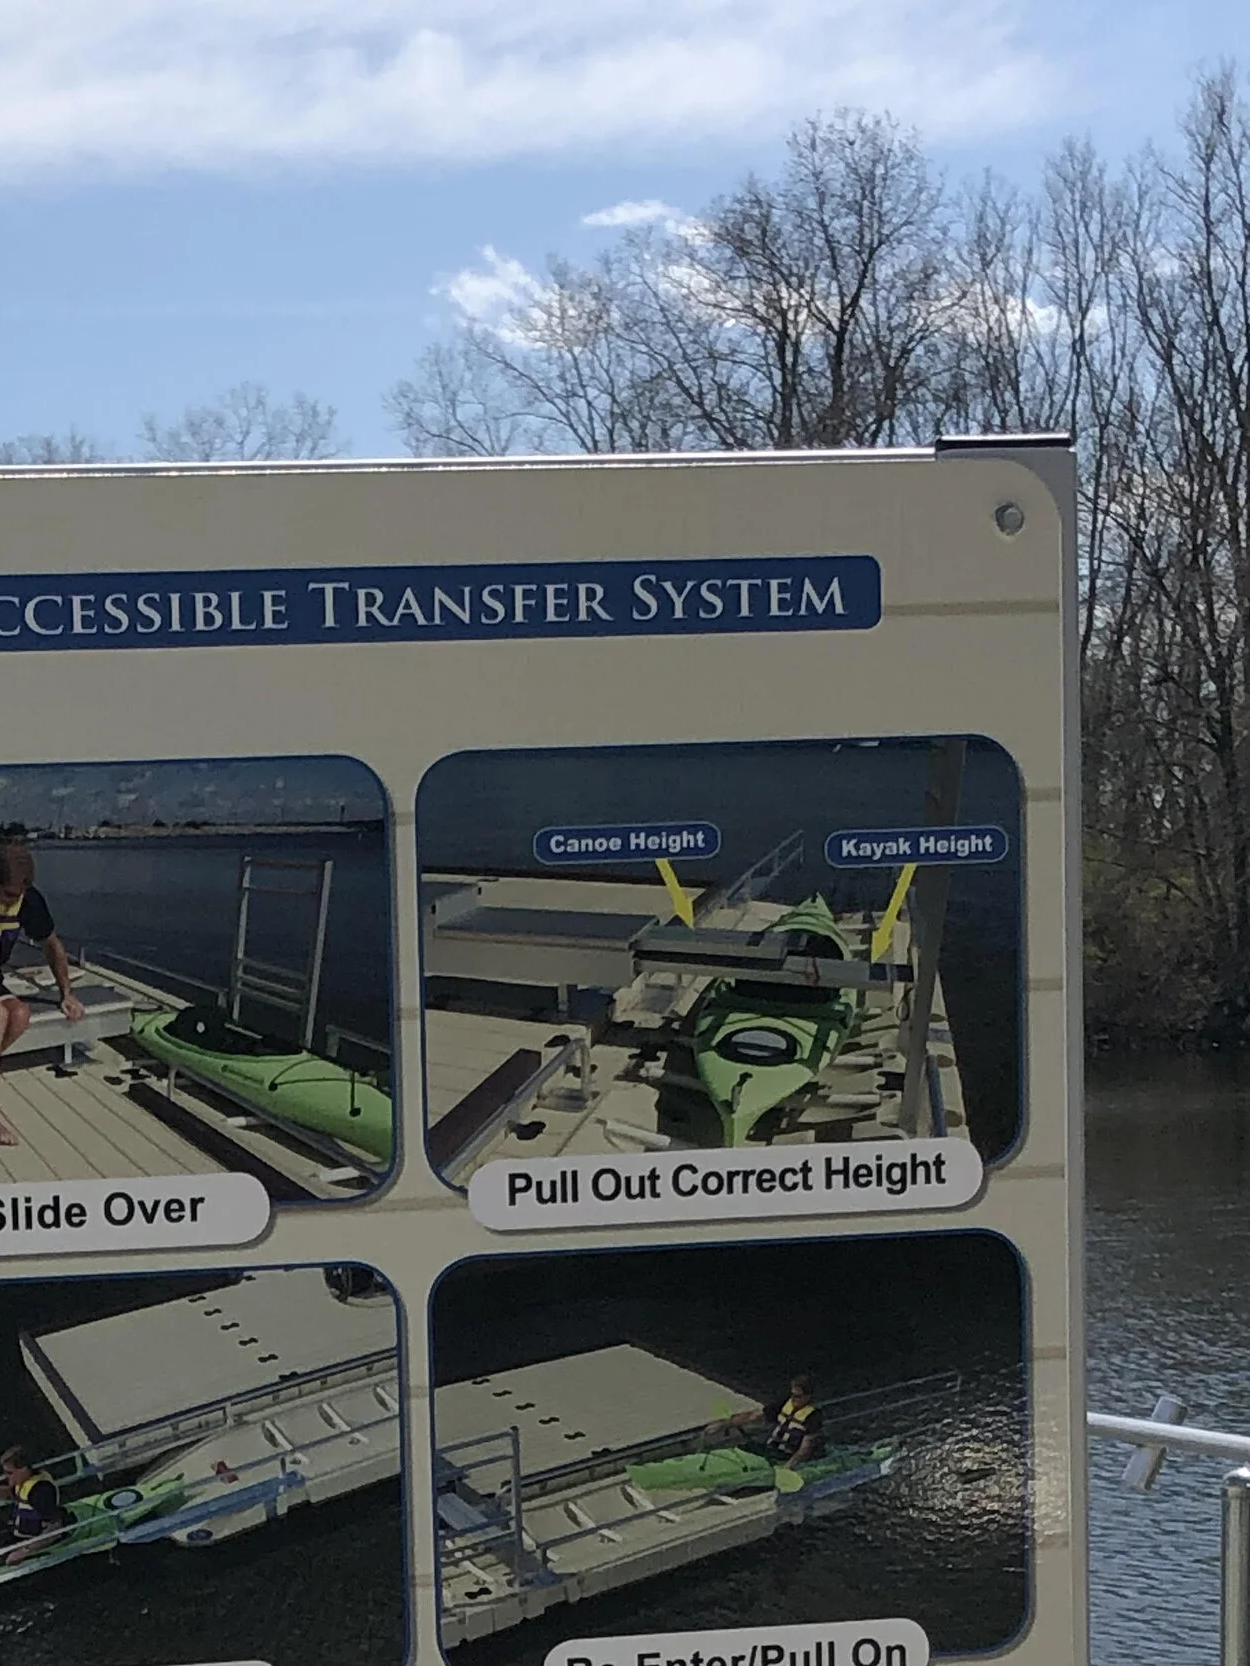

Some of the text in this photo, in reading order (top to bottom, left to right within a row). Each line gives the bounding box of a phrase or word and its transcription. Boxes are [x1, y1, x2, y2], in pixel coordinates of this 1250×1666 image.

[309, 582, 613, 627] TRANSFER
[633, 575, 844, 619] SYSTEM
[550, 831, 705, 853] Canoe Height
[842, 835, 992, 860] Kayak Height
[509, 1153, 946, 1206] Pull Out Correct Height
[104, 1192, 205, 1225] Over
